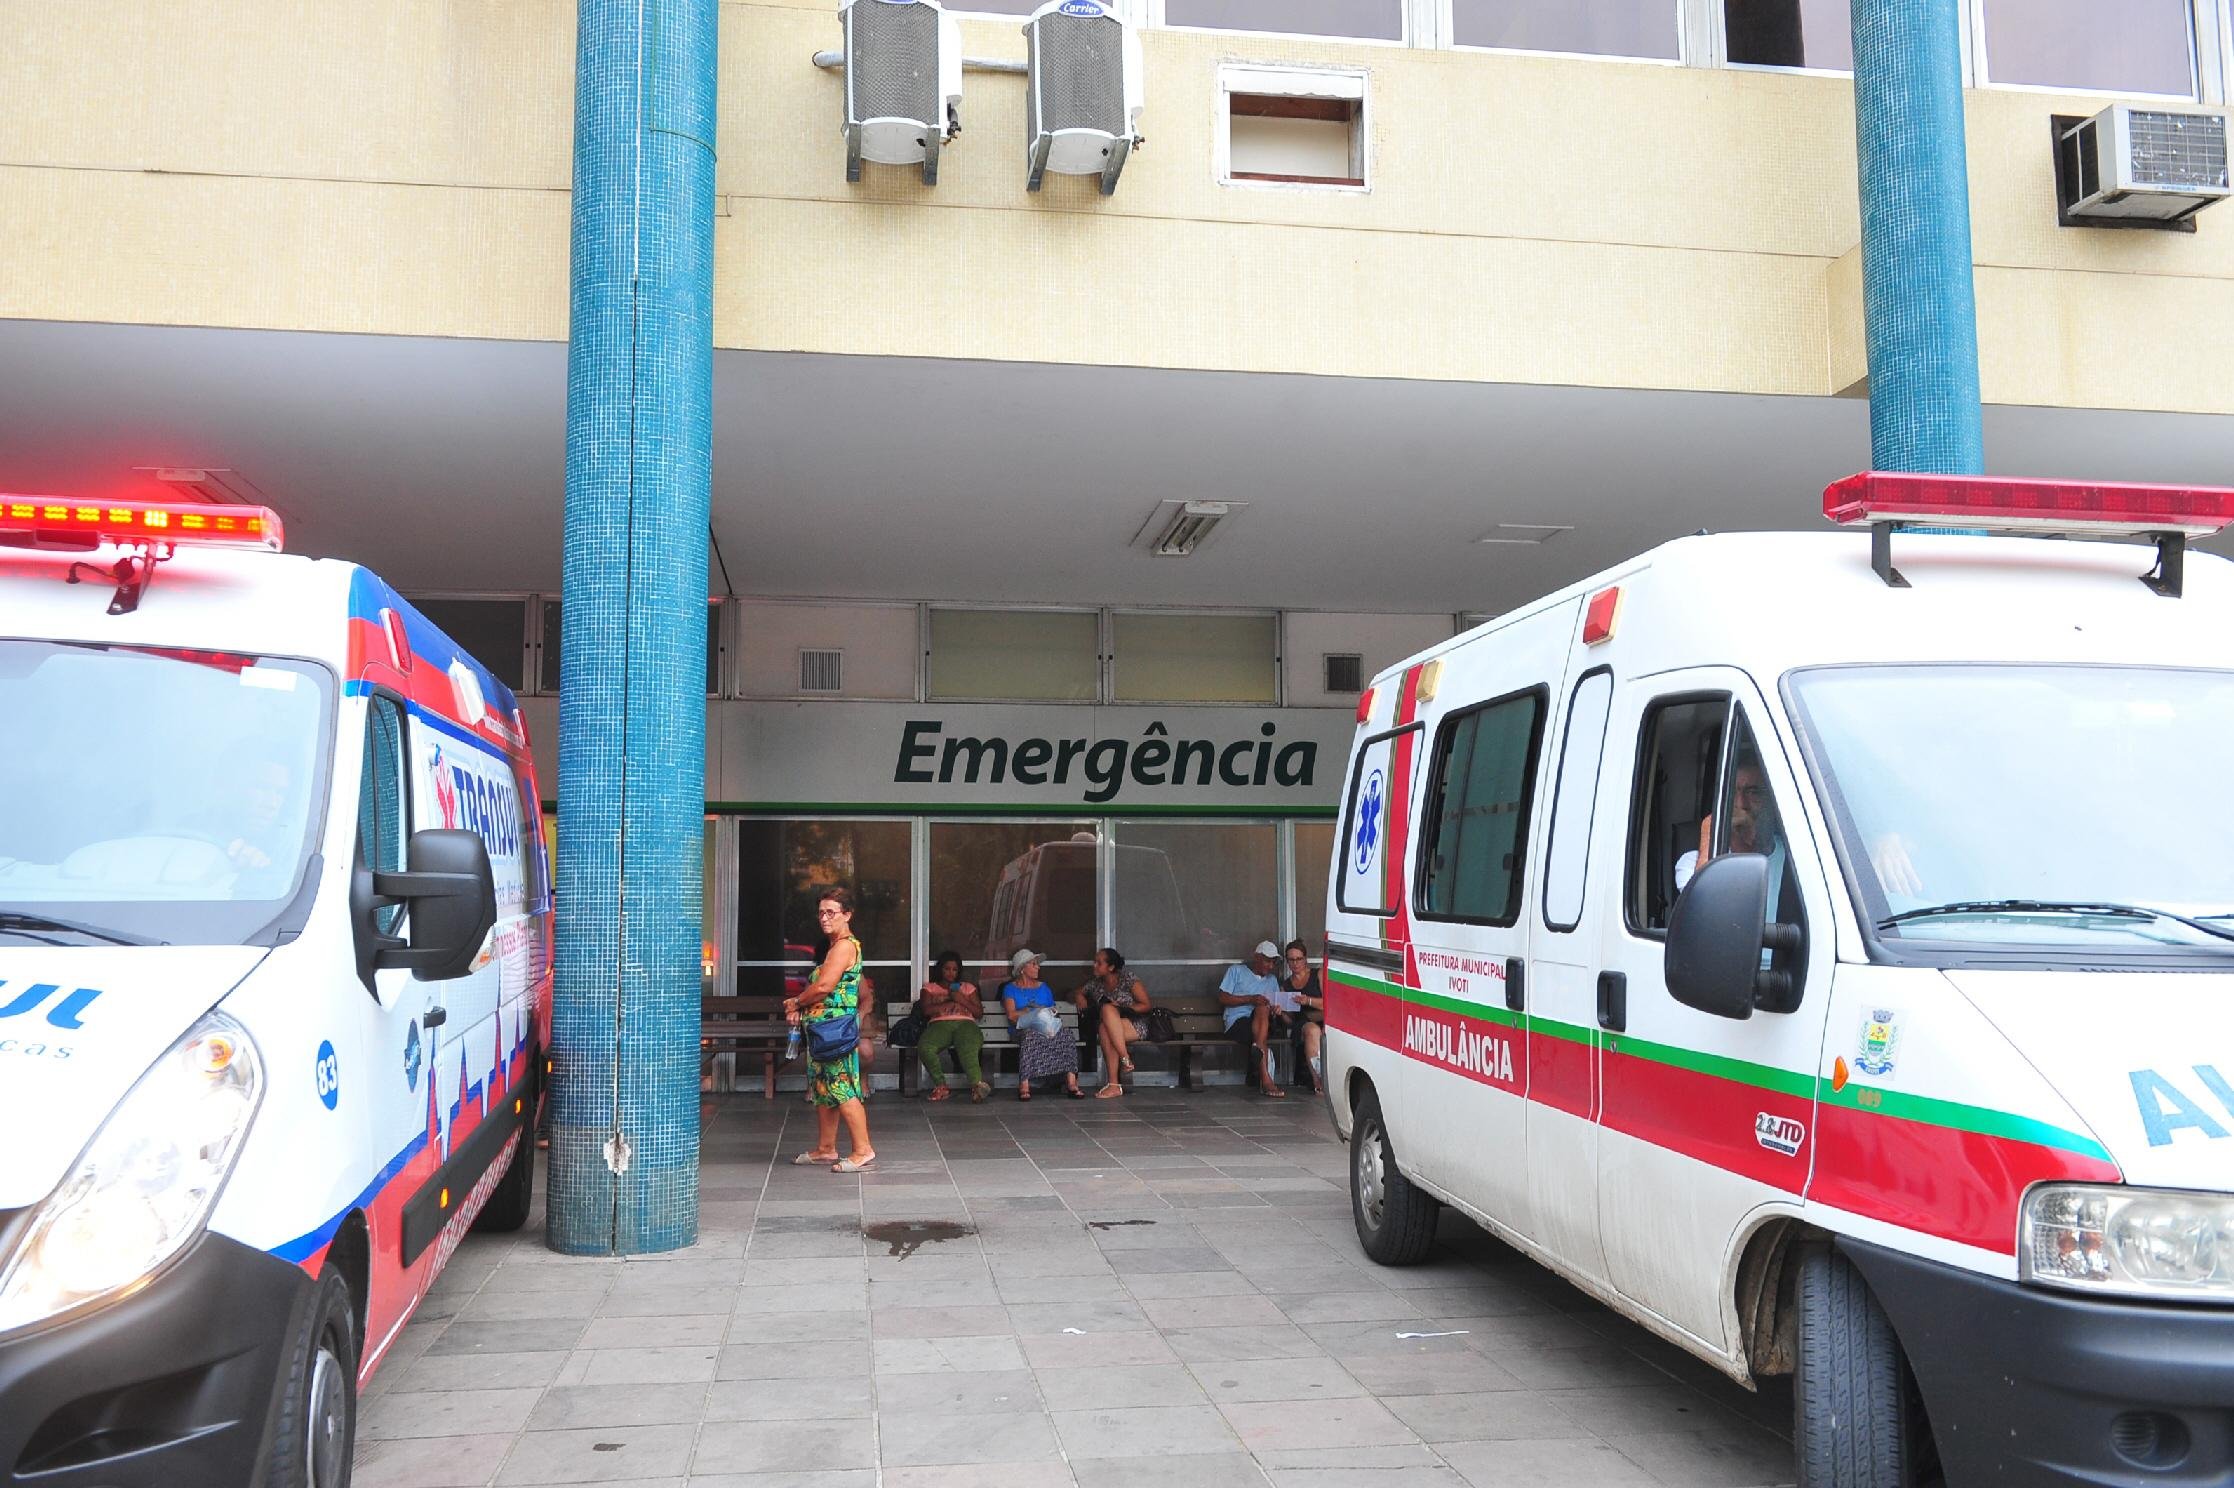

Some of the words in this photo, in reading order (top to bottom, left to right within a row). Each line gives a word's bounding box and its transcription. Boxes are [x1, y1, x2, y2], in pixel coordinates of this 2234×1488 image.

[1064, 2, 1099, 15] Carrier
[893, 720, 1318, 803] Emergência
[1419, 952, 1459, 971] PREFEITURA
[1461, 958, 1508, 980] MUNICIPAL
[1448, 976, 1469, 993] IVOTI
[1404, 1014, 1514, 1083] AMBULÂNCIA
[317, 1054, 338, 1097] 83
